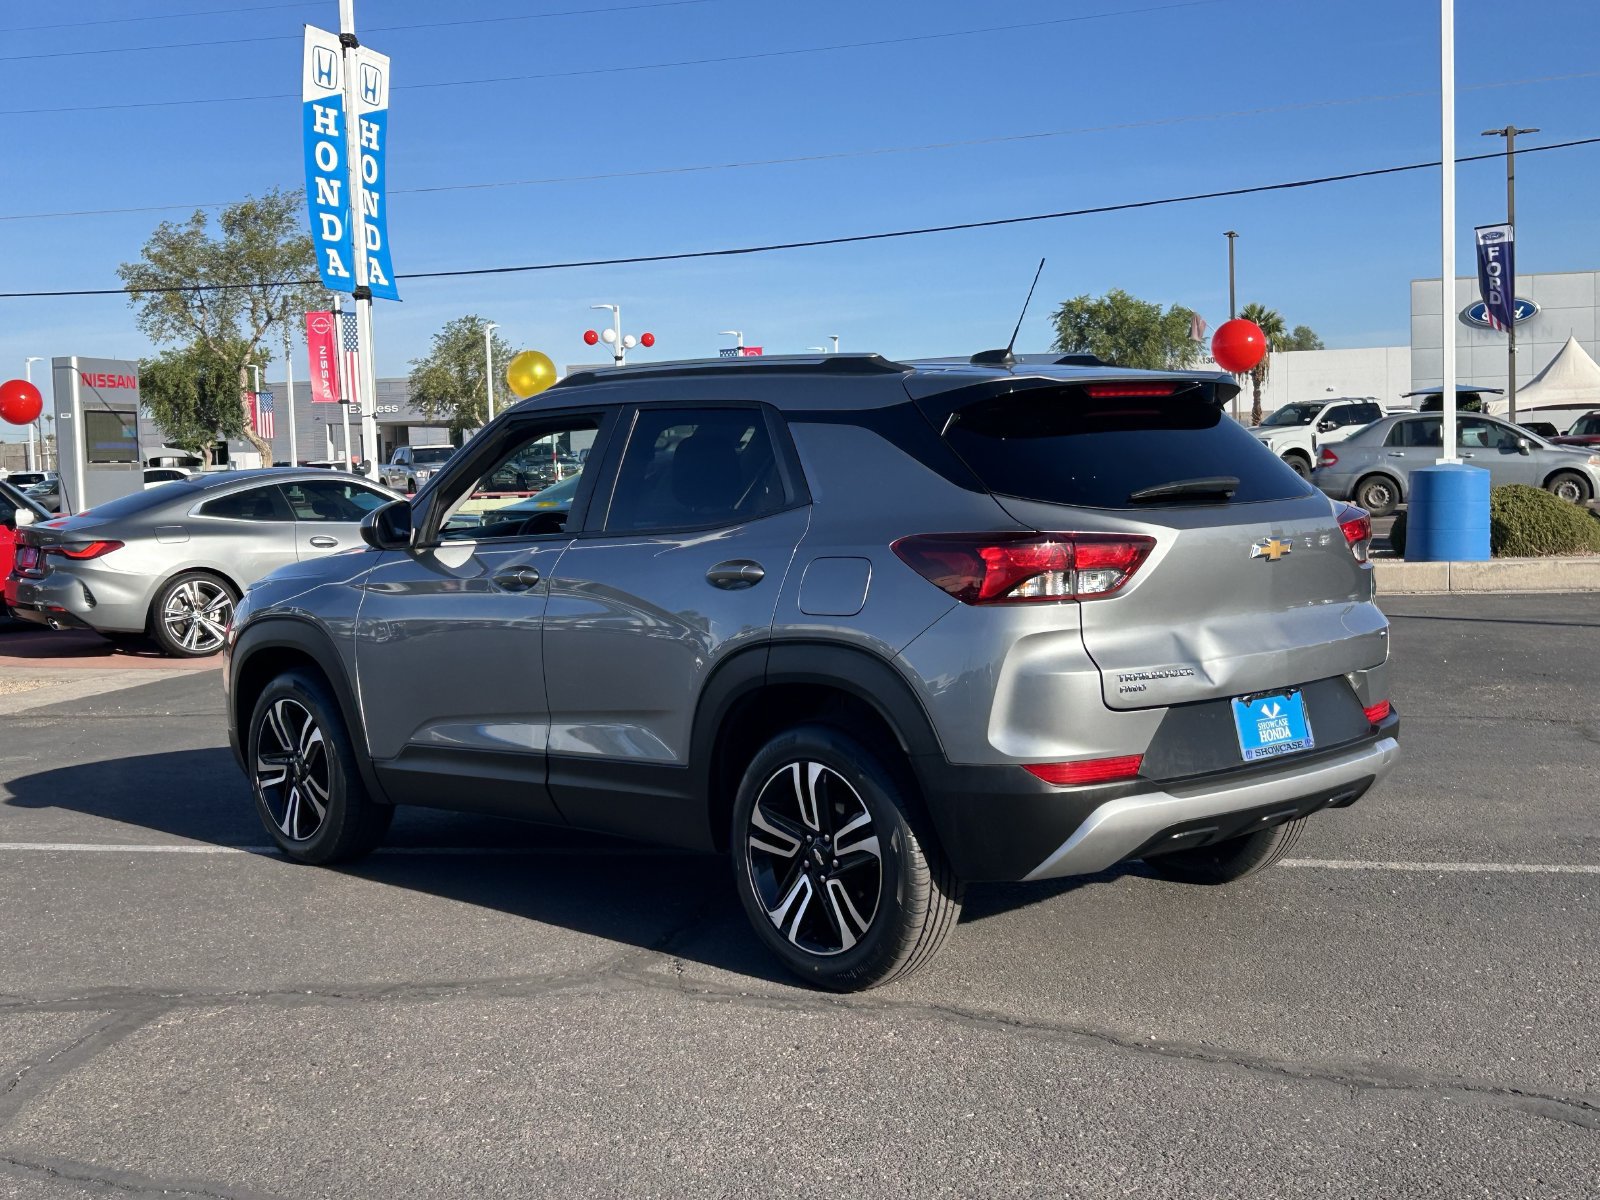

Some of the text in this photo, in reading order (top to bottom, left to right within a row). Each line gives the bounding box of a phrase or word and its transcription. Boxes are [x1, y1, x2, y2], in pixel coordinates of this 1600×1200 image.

[313, 104, 349, 278] HONDA
[360, 120, 389, 286] HONDA
[1486, 246, 1502, 305] FORD
[81, 372, 136, 389] NISSAN
[319, 346, 332, 399] NISSAN
[349, 404, 399, 414] Exess
[1257, 717, 1289, 731] SHOWCASE
[1259, 725, 1292, 743] HONDA
[1254, 740, 1304, 757] SHOWCASE
